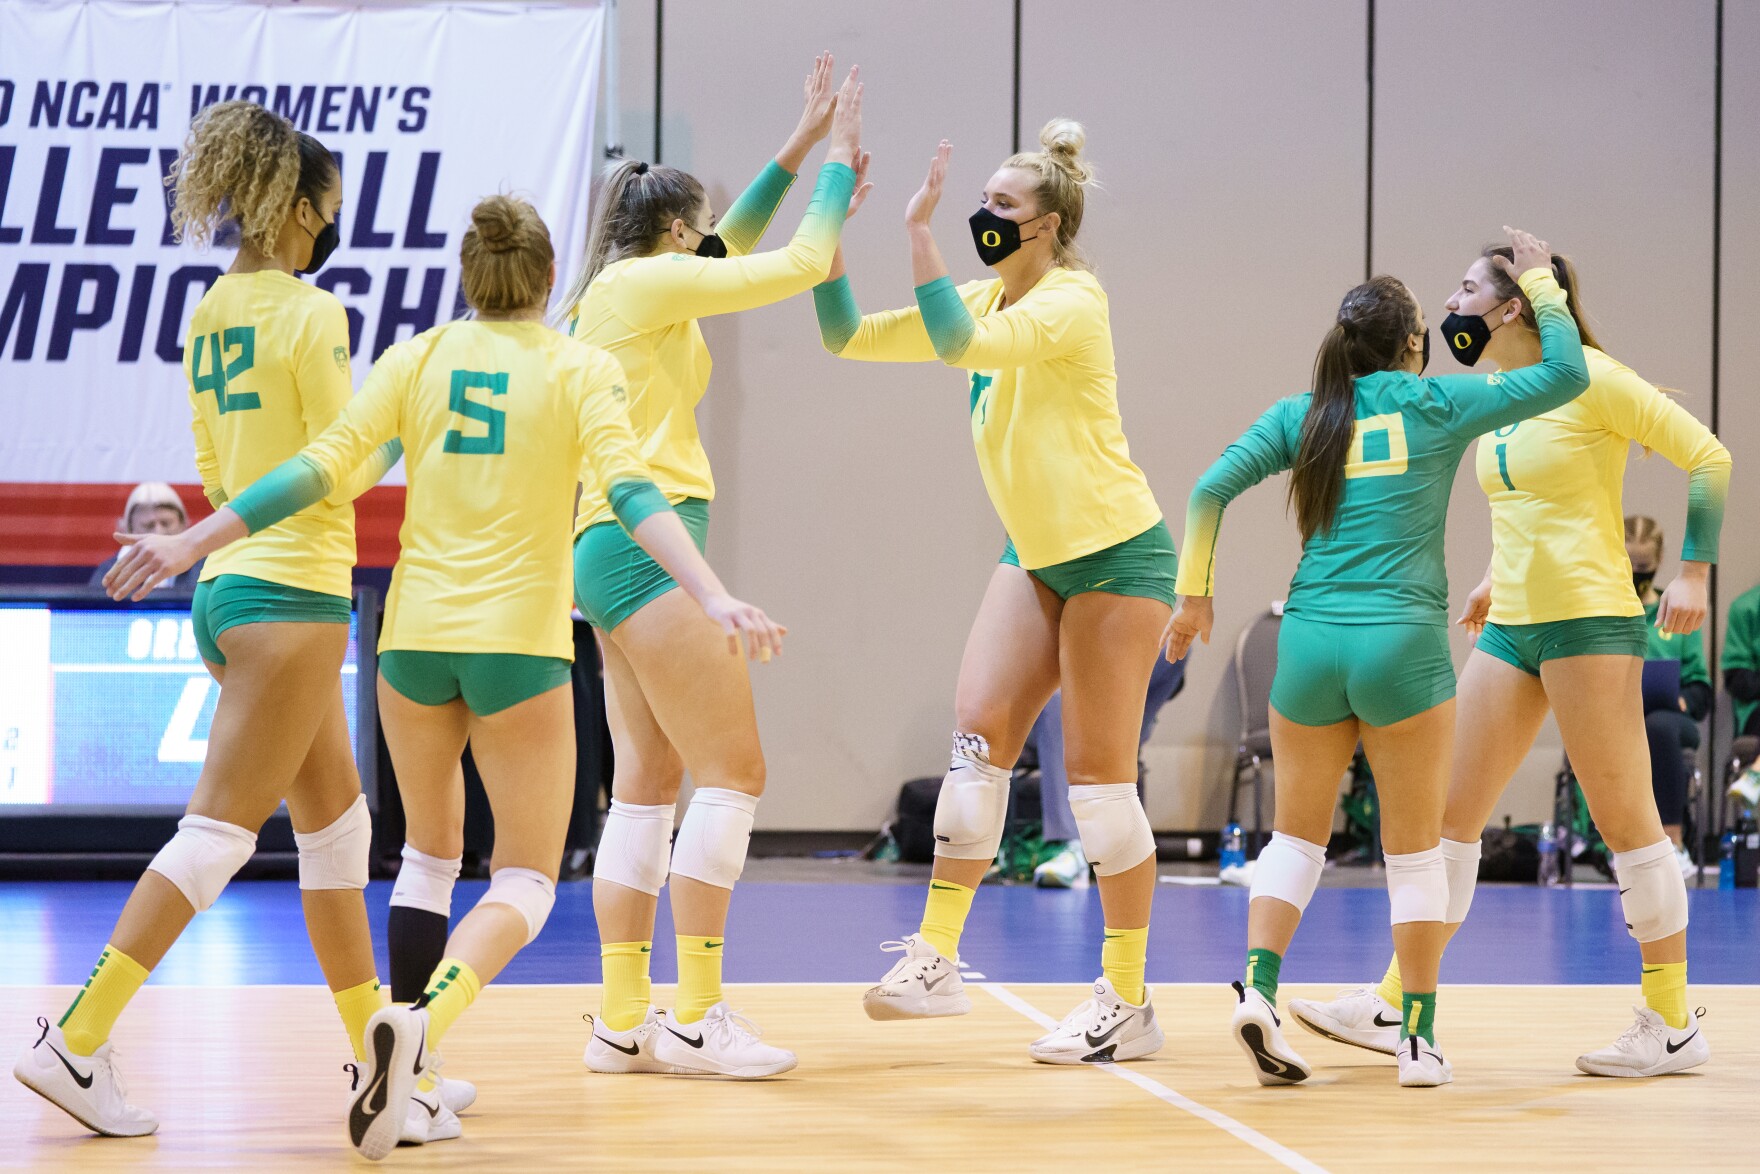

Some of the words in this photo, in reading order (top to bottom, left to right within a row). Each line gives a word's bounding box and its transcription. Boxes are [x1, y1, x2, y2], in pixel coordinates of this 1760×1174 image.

[29, 80, 160, 130] NCAA
[981, 230, 1001, 247] O
[191, 326, 262, 415] 42
[443, 369, 510, 454] 5
[1495, 443, 1516, 491] 1
